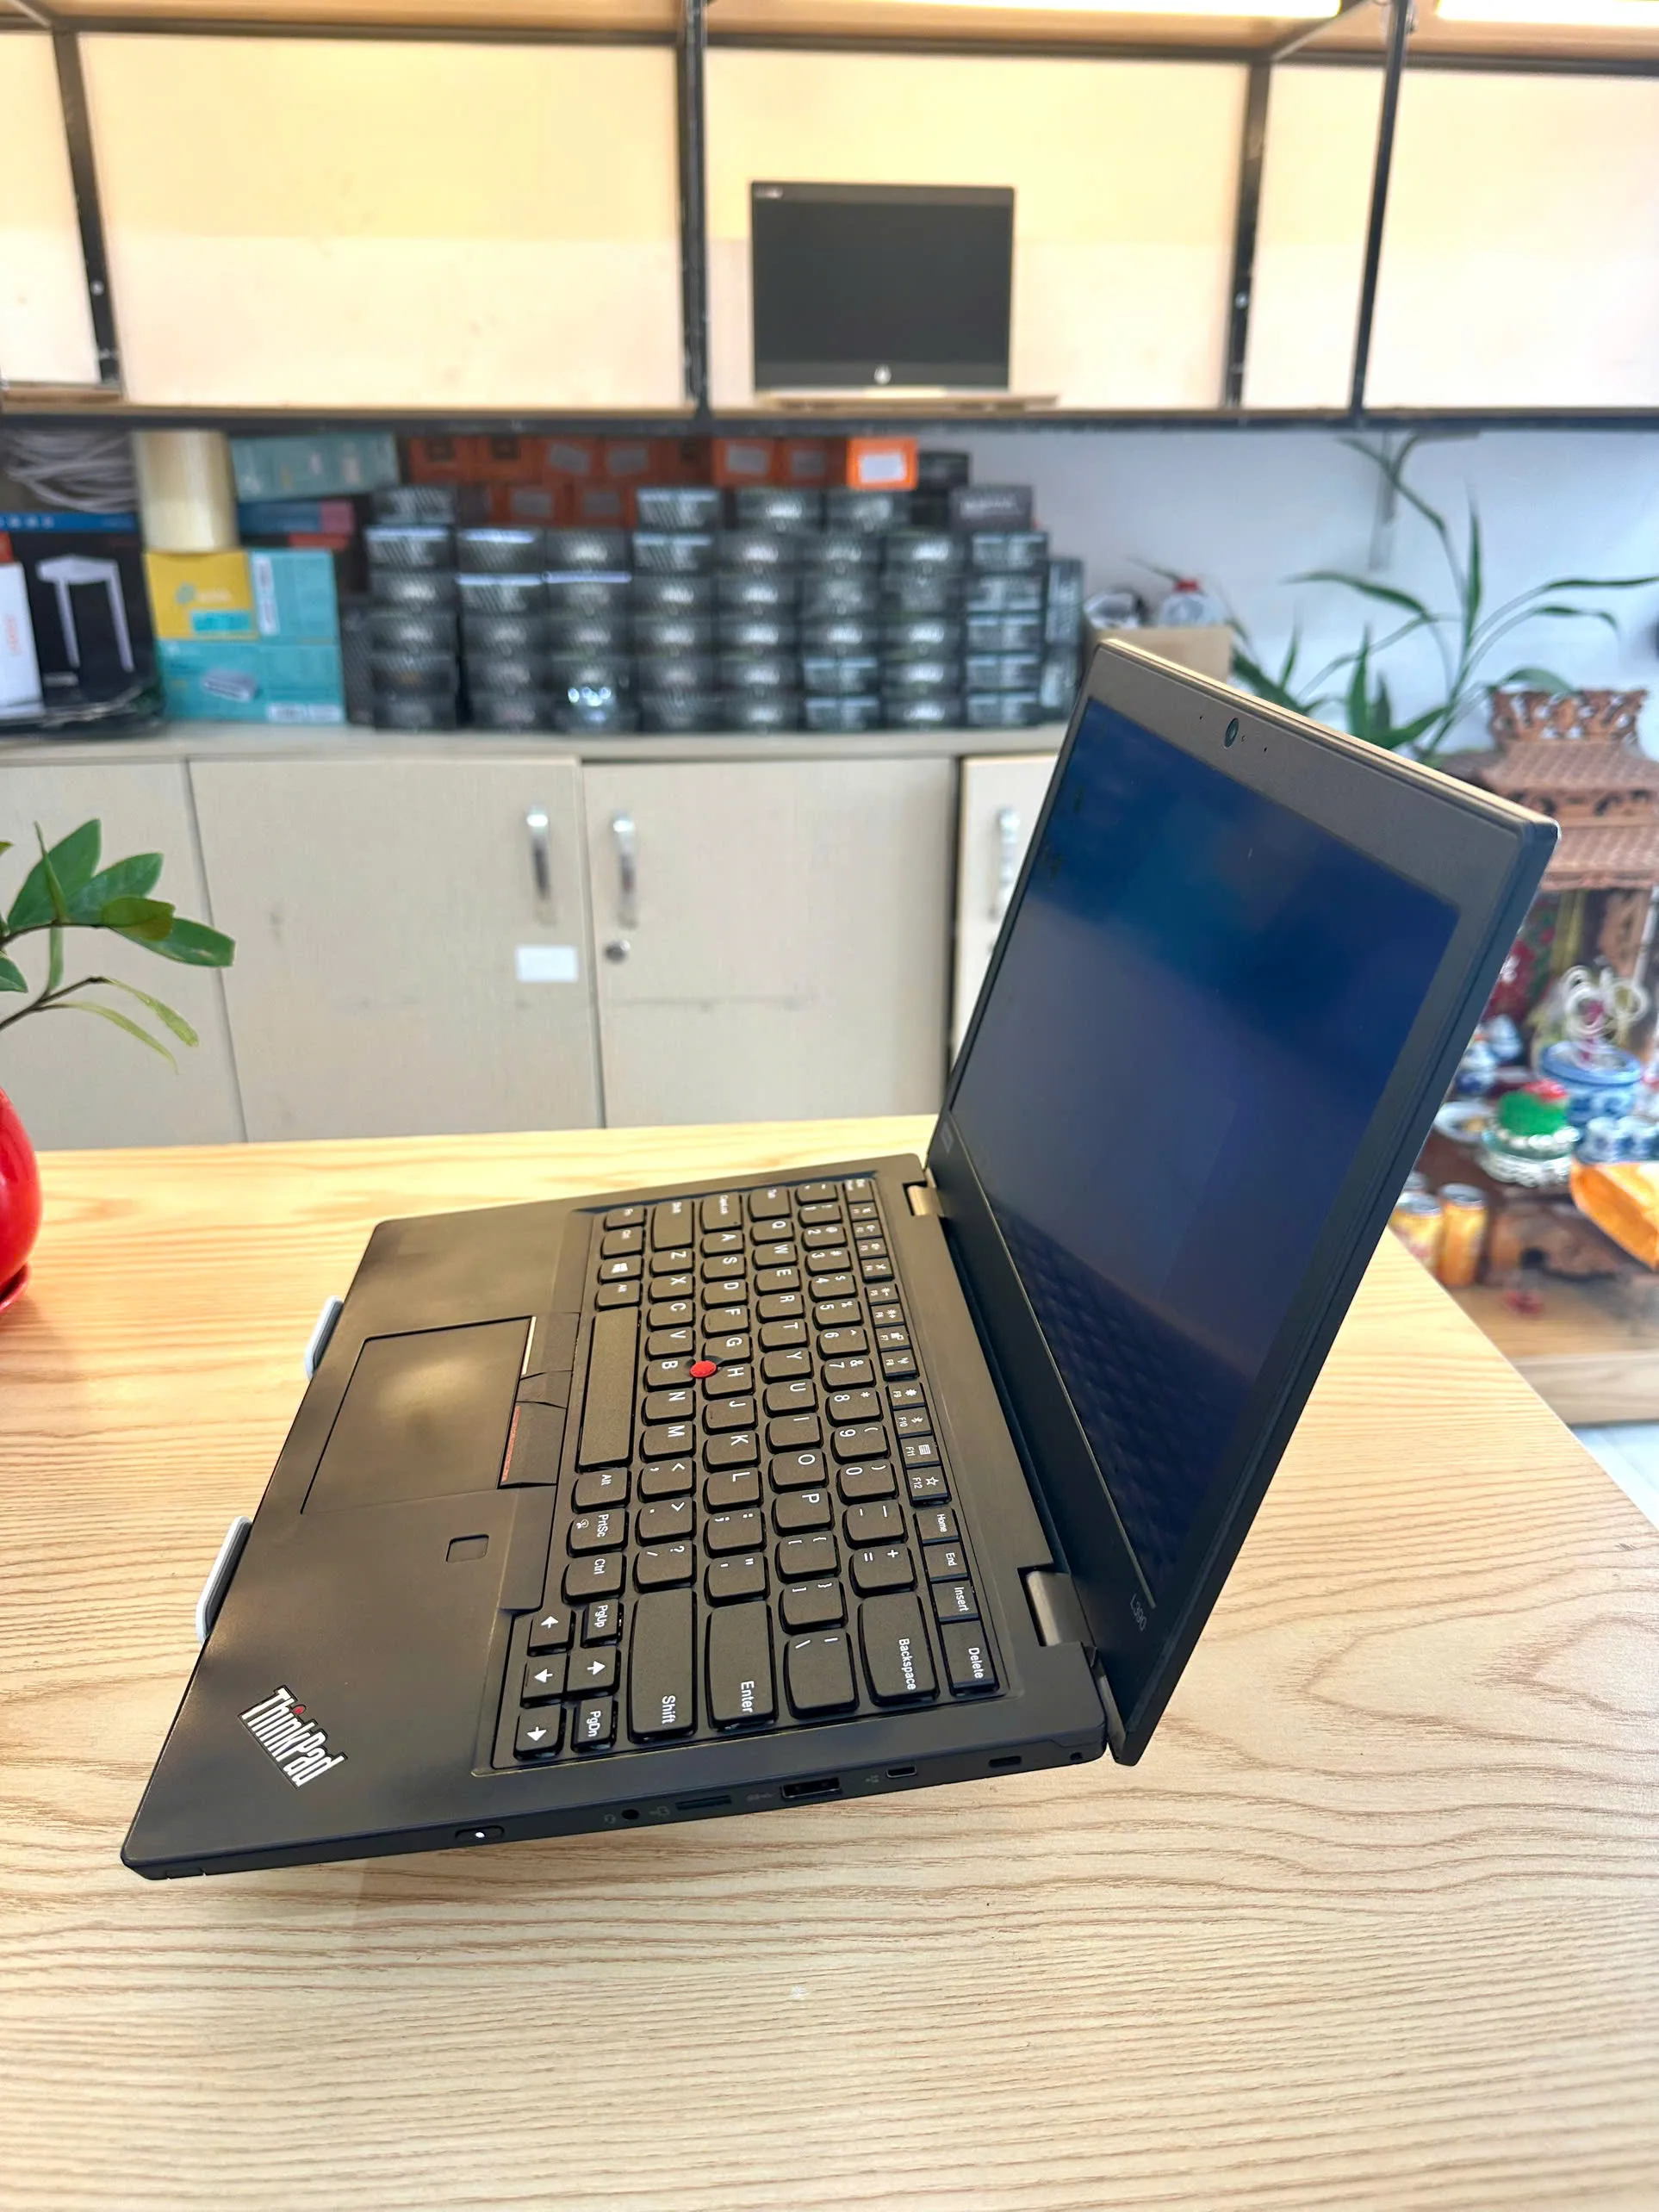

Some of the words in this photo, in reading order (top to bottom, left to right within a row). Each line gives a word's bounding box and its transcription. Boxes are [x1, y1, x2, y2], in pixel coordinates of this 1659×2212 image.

[722, 1233, 736, 1242] A
[774, 1245, 788, 1253] W
[670, 1251, 687, 1259] Z
[723, 1256, 738, 1264] S
[724, 1282, 739, 1290] D
[780, 1295, 795, 1303] R
[783, 1321, 798, 1330] T
[669, 1330, 687, 1339] V
[727, 1338, 742, 1346] G
[849, 1359, 864, 1368] &
[728, 1367, 744, 1376] H
[790, 1382, 806, 1391] U
[669, 1392, 685, 1401] N
[834, 1394, 851, 1402] 8
[898, 1417, 908, 1426] F10
[668, 1426, 685, 1437] M
[731, 1435, 749, 1445] K
[906, 1447, 915, 1456] F11
[798, 1454, 815, 1464] O
[601, 1475, 612, 1485] Alt
[733, 1472, 750, 1482] L
[913, 1477, 923, 1488] F12
[802, 1494, 819, 1503] P
[597, 1514, 608, 1537] PrtSc
[937, 1514, 947, 1532] Home
[946, 1553, 957, 1566] End
[594, 1559, 605, 1574] Ctrl
[954, 1588, 969, 1612] Insert
[594, 1605, 607, 1627] PgUp
[899, 1638, 916, 1689] Backspace
[969, 1648, 984, 1678] Delete
[742, 1681, 754, 1712] Enter
[662, 1696, 675, 1724] Shift
[587, 1711, 600, 1737] PgDn
[241, 1687, 345, 1787] ThinkPad
